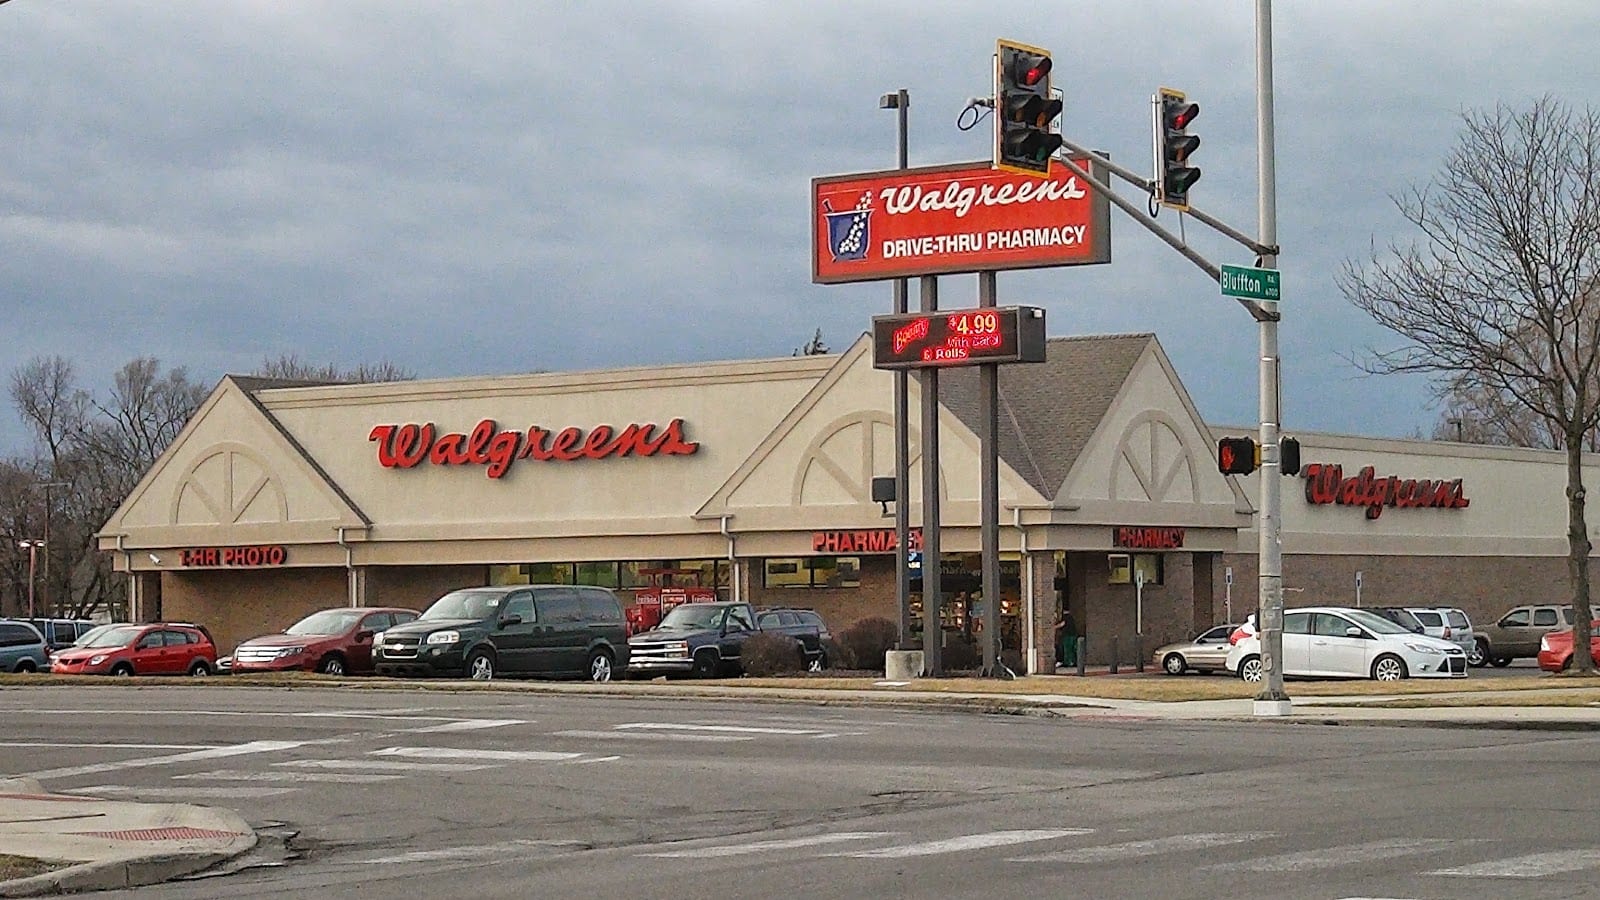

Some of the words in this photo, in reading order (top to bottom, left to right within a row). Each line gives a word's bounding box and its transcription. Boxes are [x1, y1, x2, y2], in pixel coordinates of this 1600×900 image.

[880, 175, 1086, 217] Walgreens
[883, 232, 982, 259] DRIVE-THRU
[987, 225, 1086, 249] PHARMACY
[1222, 271, 1260, 293] Bluffton
[935, 348, 967, 360] Rolls
[369, 419, 700, 479] Walgreens
[1301, 463, 1470, 519] Walgreens
[1114, 526, 1186, 549] PHARMACY
[223, 545, 287, 567] PHOTO
